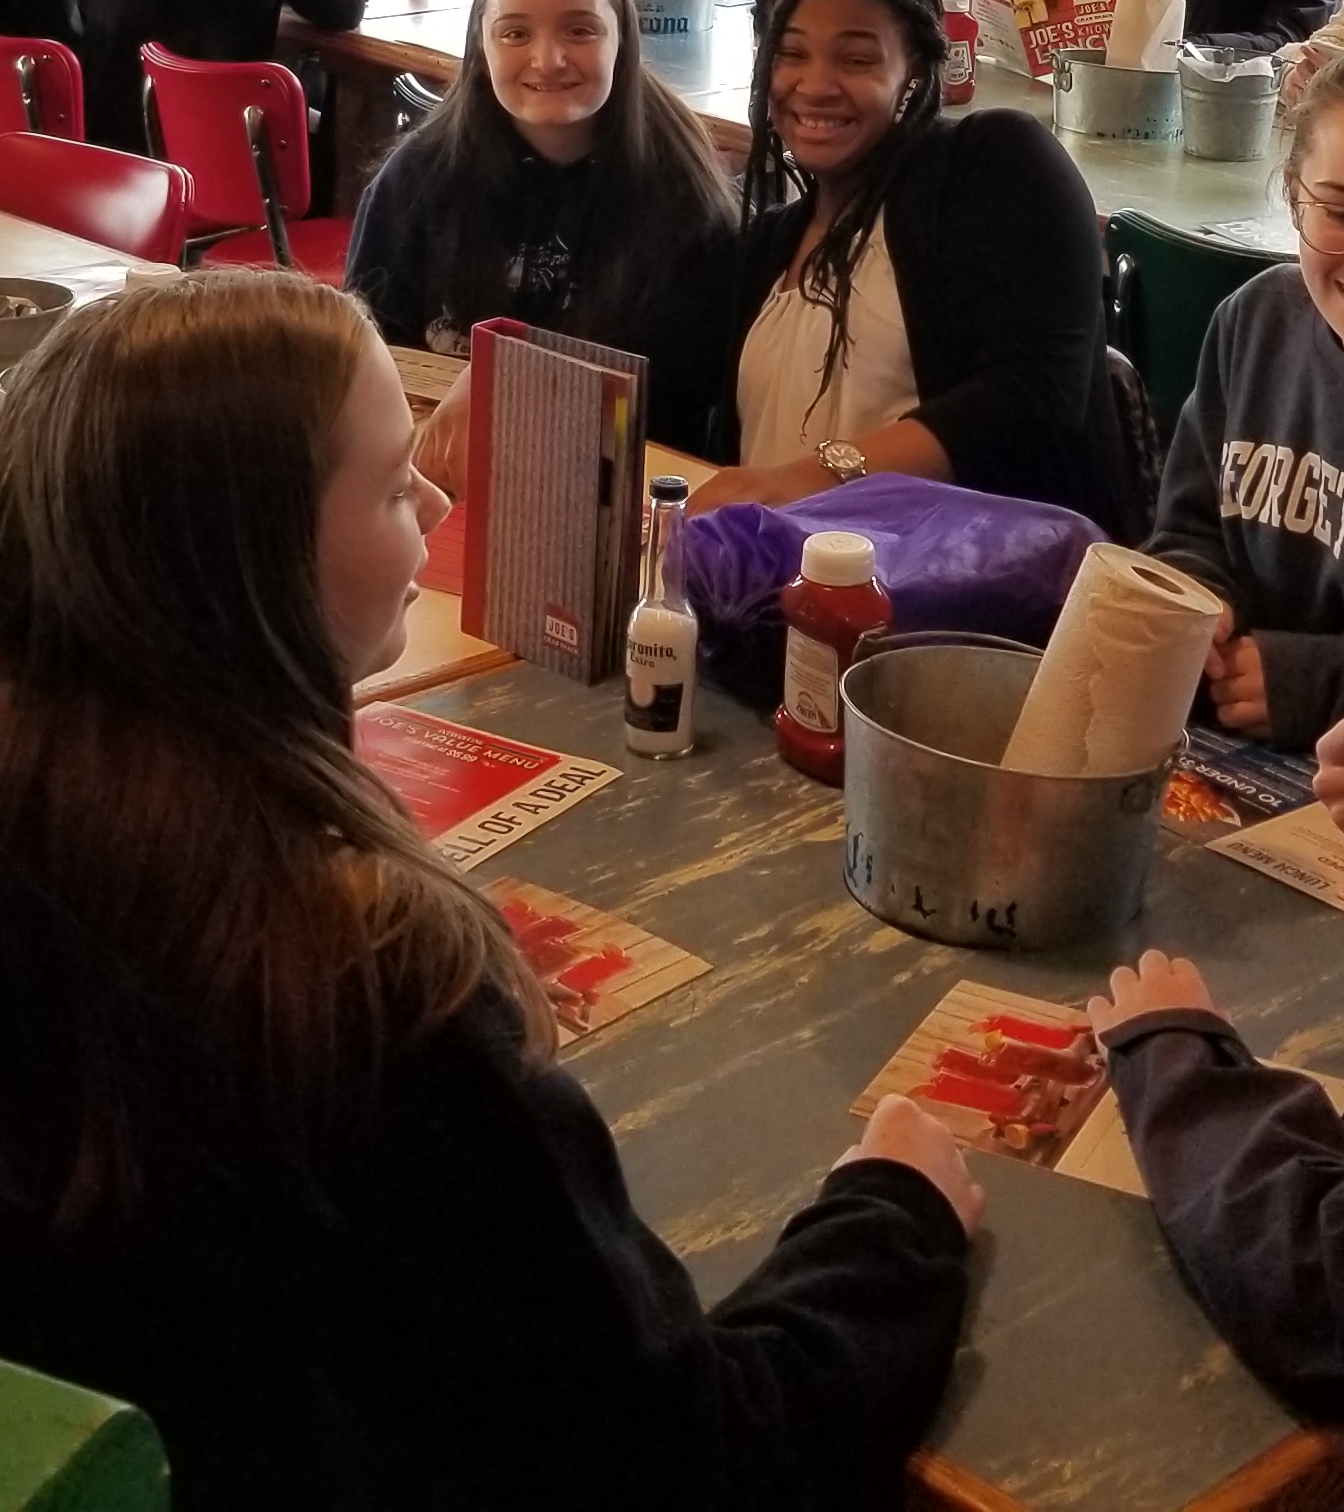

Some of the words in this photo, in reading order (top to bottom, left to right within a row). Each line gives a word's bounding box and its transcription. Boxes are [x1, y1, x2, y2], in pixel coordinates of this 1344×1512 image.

[1078, 2, 1106, 15] JOE'S
[638, 16, 690, 34] rona
[1028, 22, 1075, 48] JOE'S
[548, 619, 575, 641] JOE'S
[628, 639, 675, 659] ronita
[630, 651, 656, 668] Extra
[424, 730, 483, 753] VALUE
[483, 749, 541, 770] MENU
[528, 765, 607, 803] DEAL
[1195, 764, 1257, 795] UNDER
[512, 801, 550, 816] A
[1258, 793, 1283, 808] 10
[477, 811, 524, 836] OF
[441, 834, 498, 864] ELL
[1226, 841, 1274, 869] MENU
[1274, 860, 1331, 891] LUNCH
